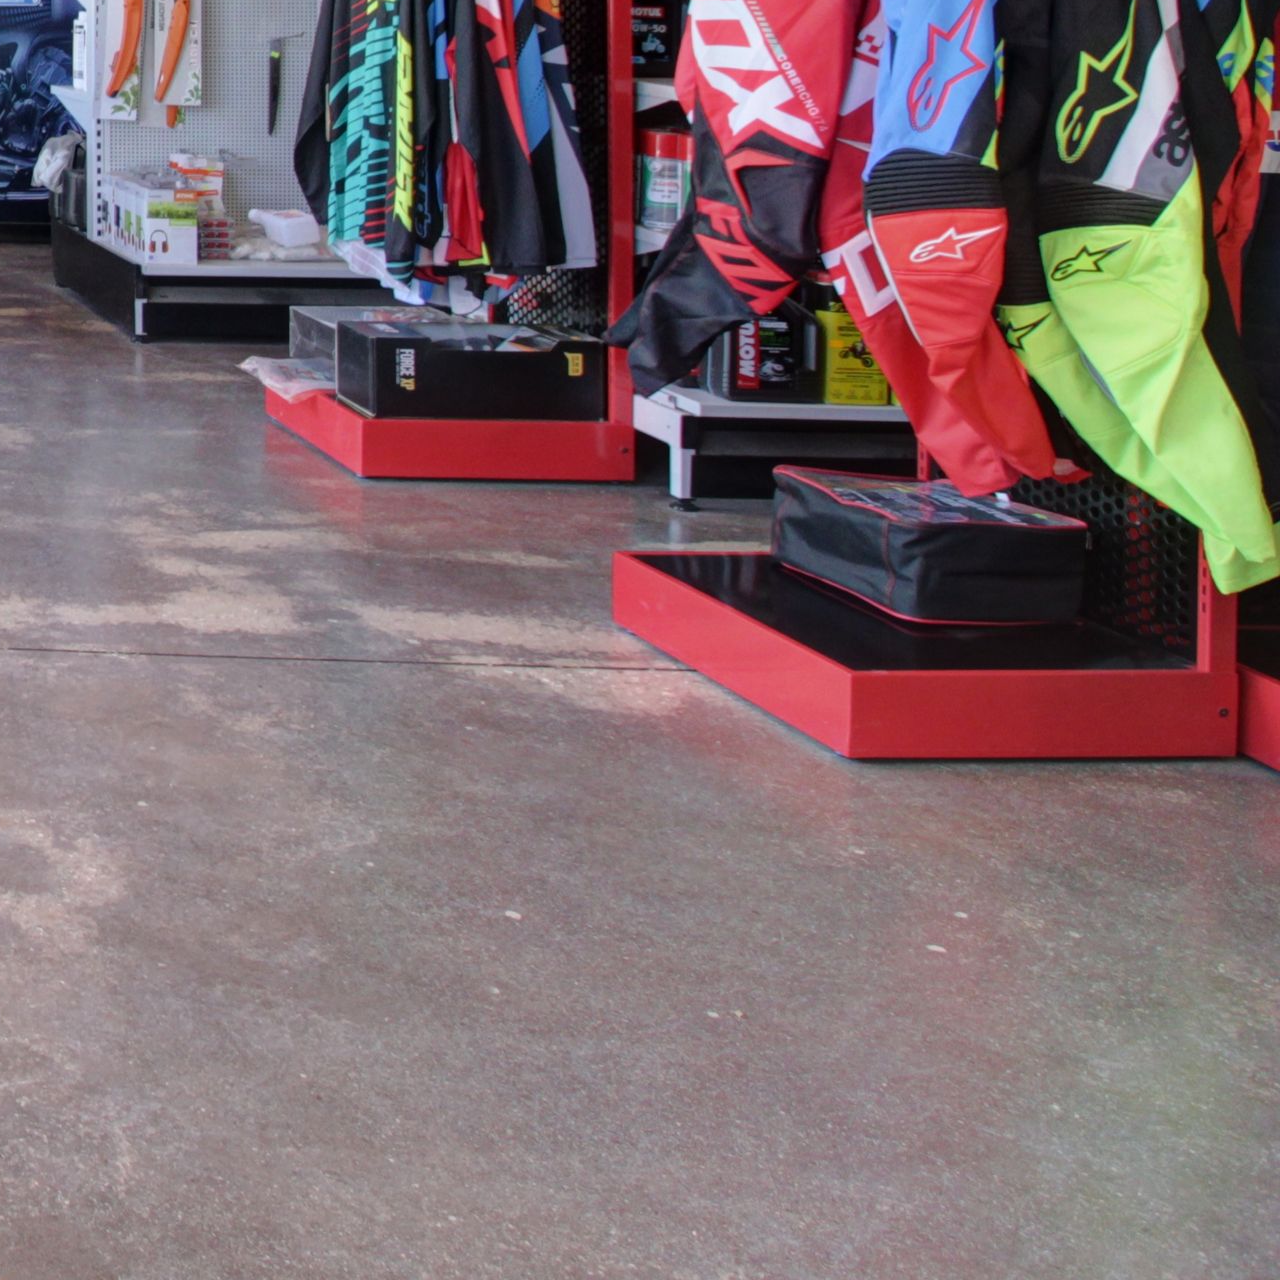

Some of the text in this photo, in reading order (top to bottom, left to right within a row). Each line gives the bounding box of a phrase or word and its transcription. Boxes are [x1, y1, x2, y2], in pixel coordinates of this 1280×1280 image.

[400, 349, 416, 391] FORCE XP
[738, 319, 756, 378] MOTU
